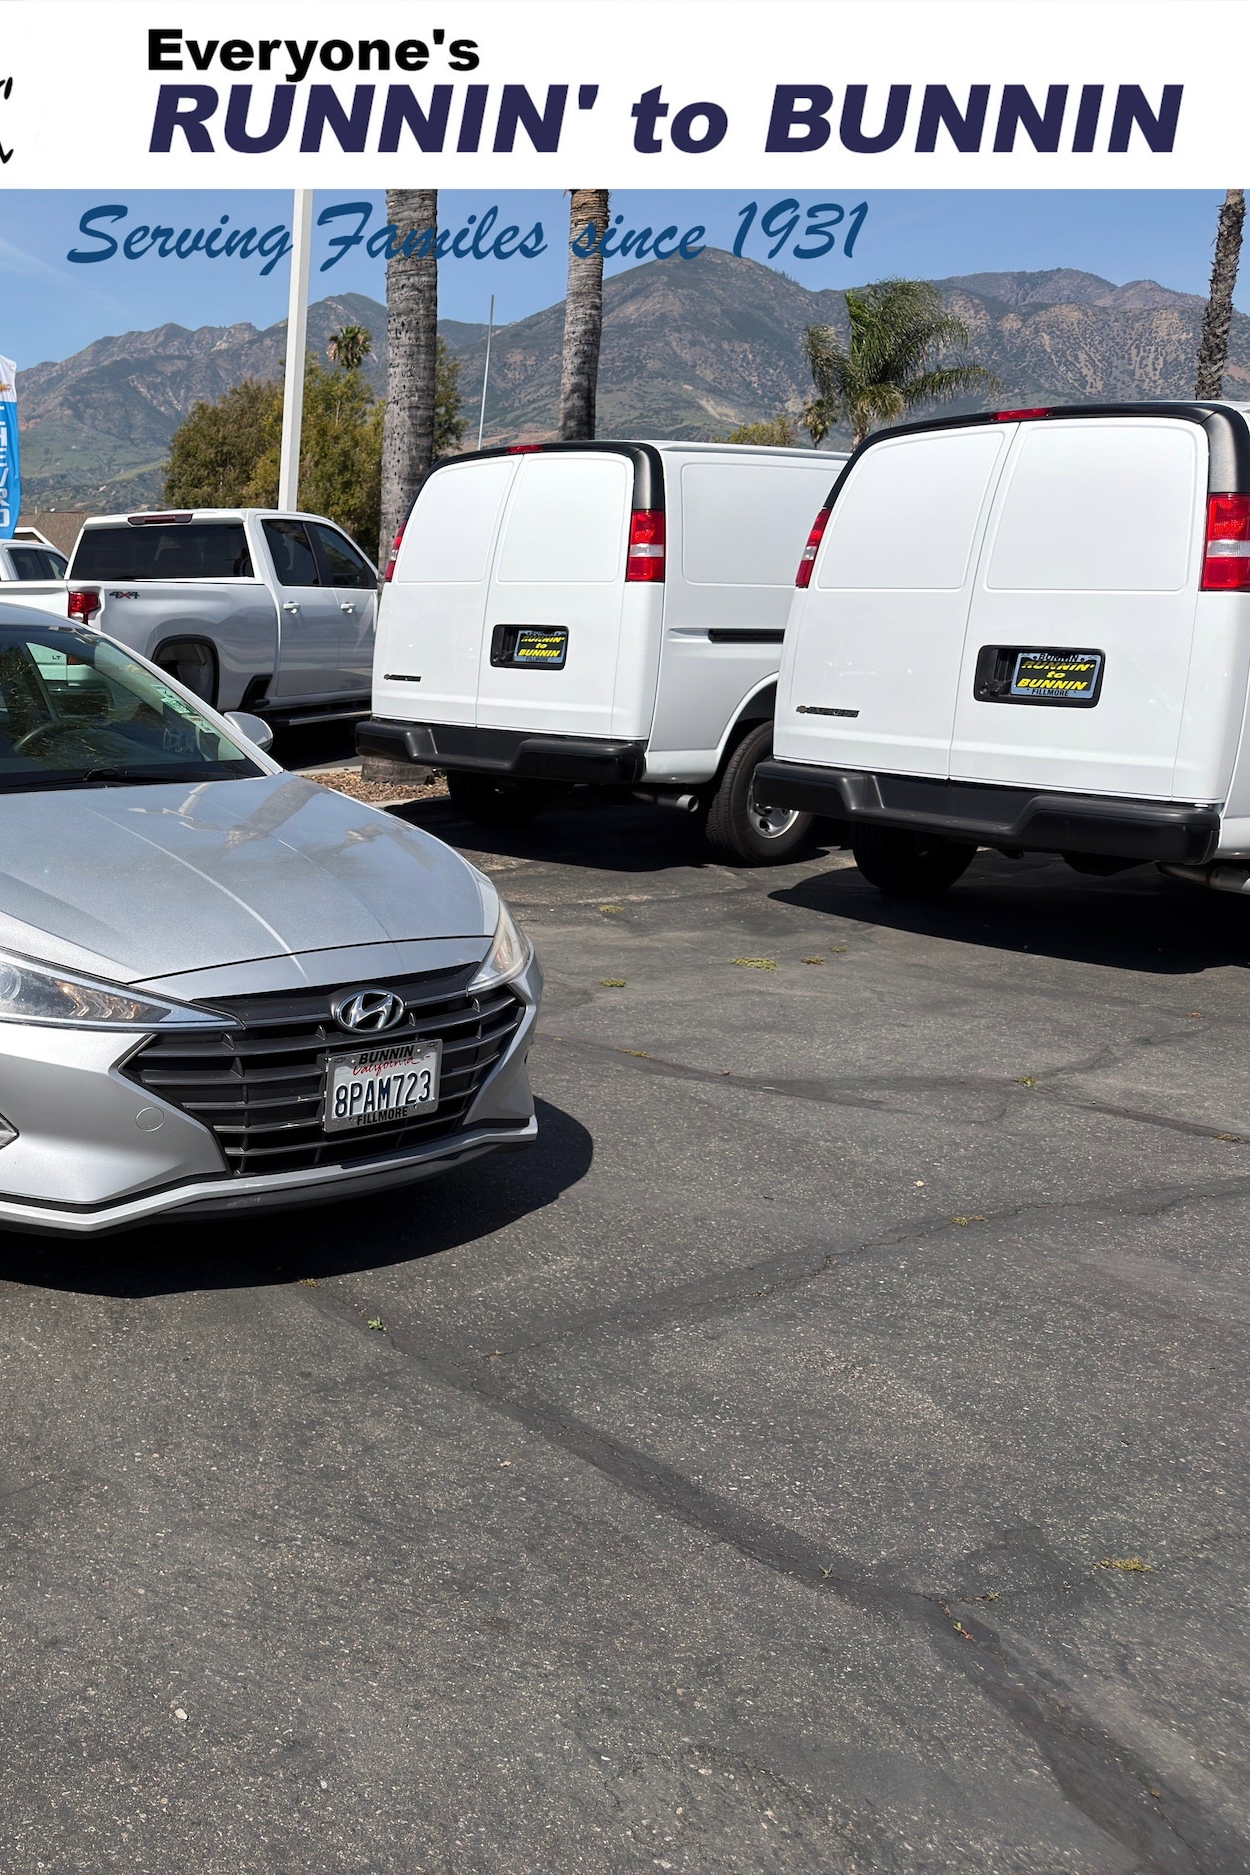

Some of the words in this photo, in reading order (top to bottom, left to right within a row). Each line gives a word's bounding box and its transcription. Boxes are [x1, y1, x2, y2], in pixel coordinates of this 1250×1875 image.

[518, 649, 561, 657] BUNNIN
[1021, 660, 1095, 671] RUNNIN'
[1046, 671, 1066, 679] to
[1017, 678, 1088, 690] BUNNIN
[1031, 688, 1070, 697] FILLMORE
[358, 1044, 415, 1065] BUNNIN
[334, 1069, 431, 1118] 8PAM723
[357, 1106, 408, 1126] FILLMORE
